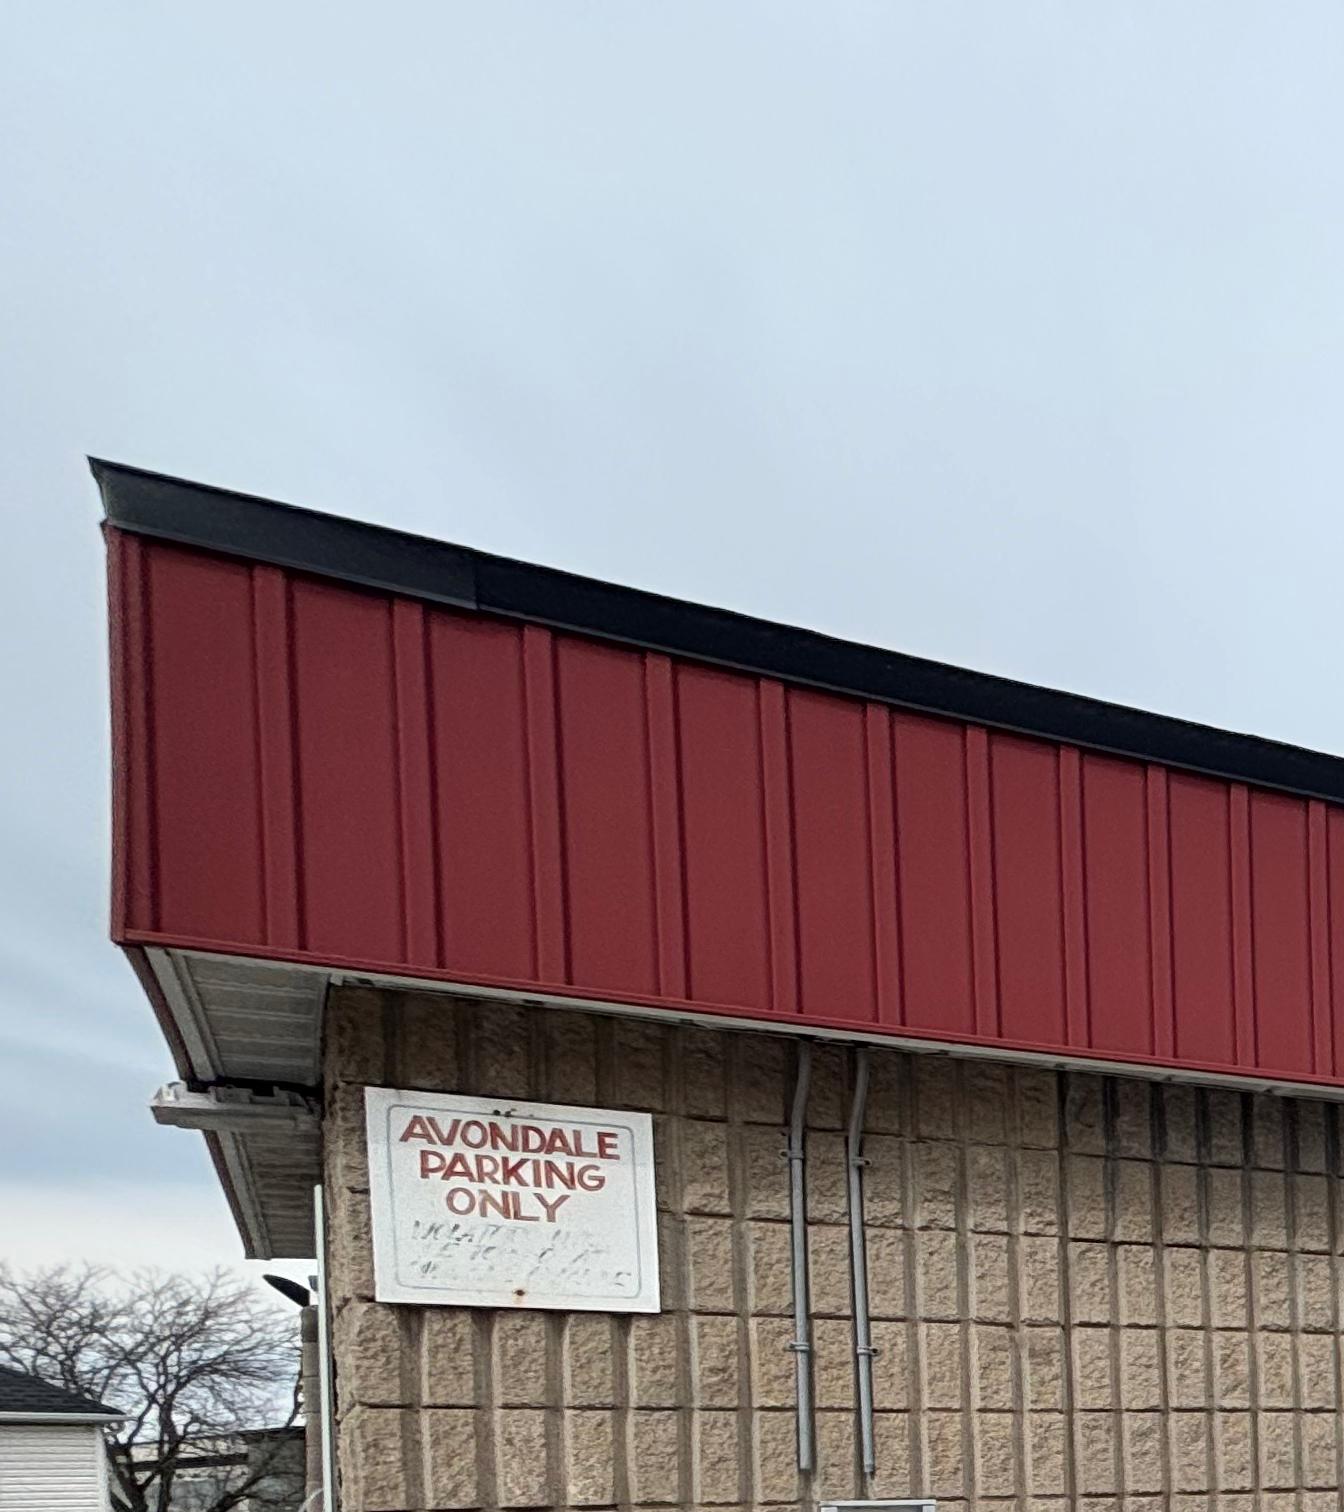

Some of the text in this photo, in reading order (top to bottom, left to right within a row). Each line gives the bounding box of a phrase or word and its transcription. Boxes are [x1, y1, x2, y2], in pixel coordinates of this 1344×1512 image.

[400, 1115, 620, 1161] AVONDALE
[420, 1149, 606, 1192] PARKING
[446, 1187, 571, 1223] ONLY
